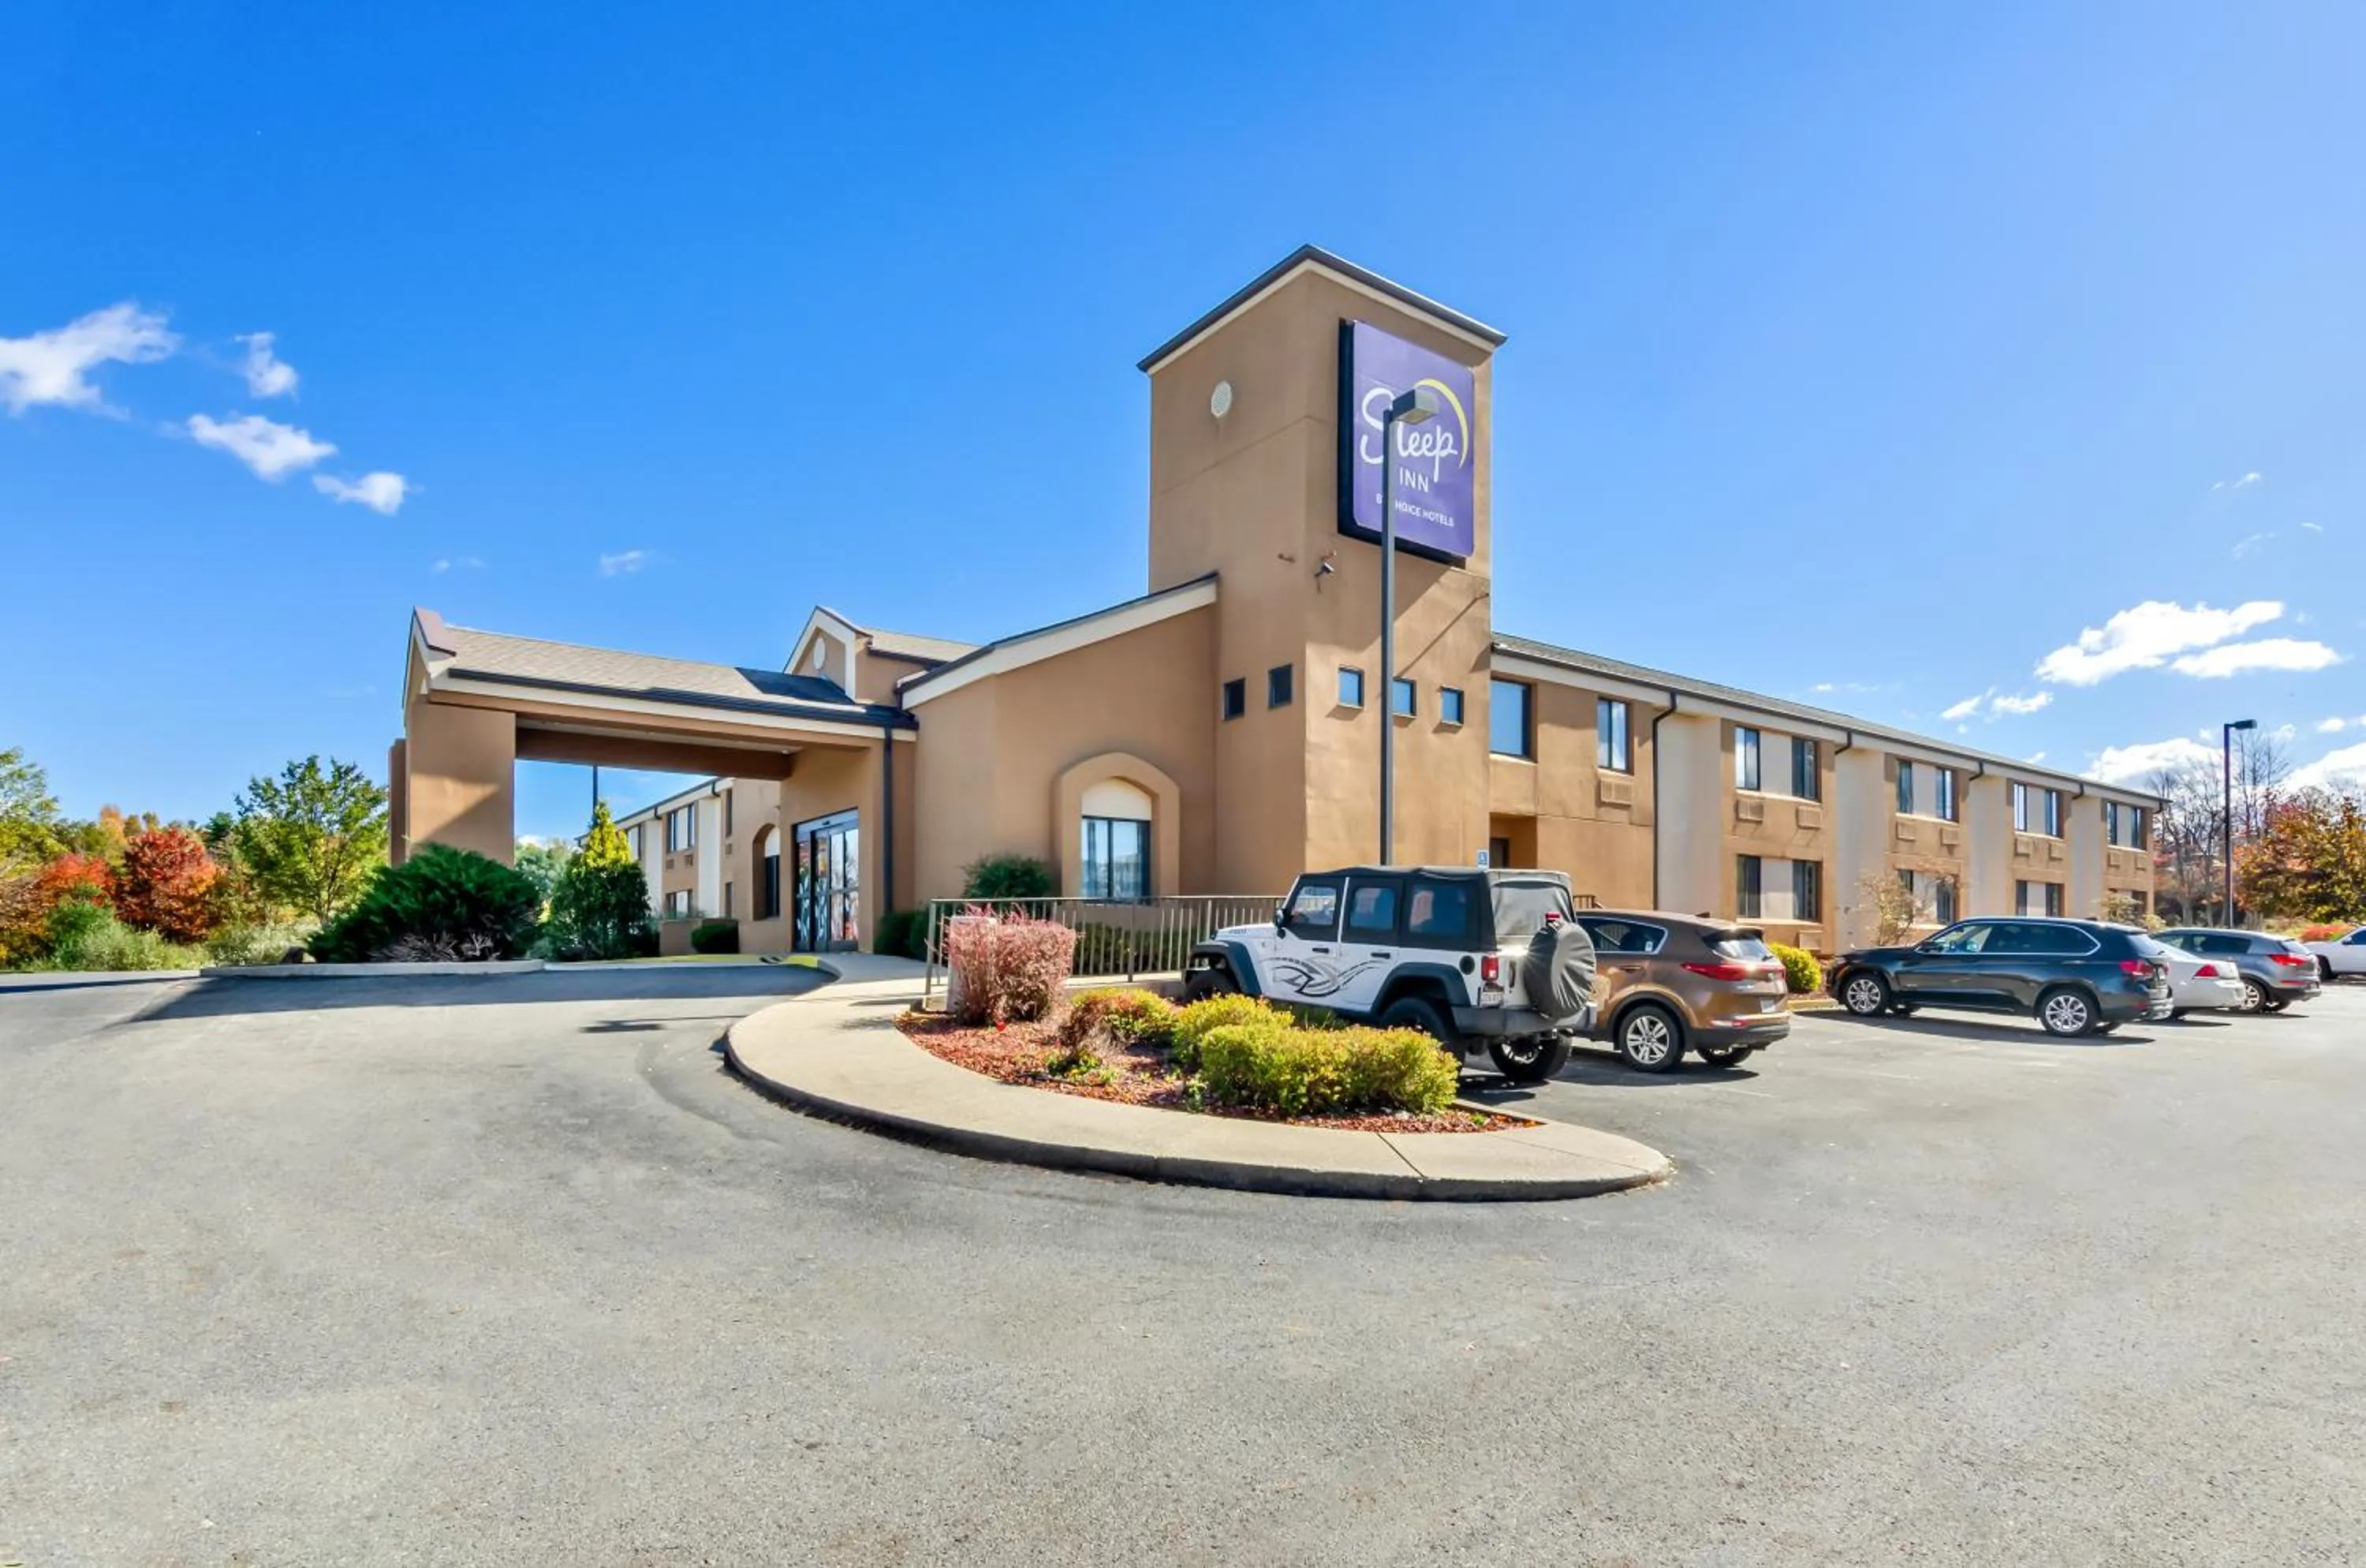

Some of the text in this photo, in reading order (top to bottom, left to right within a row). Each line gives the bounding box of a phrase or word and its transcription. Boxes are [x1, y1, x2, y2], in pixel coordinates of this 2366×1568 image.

[1360, 387, 1457, 483] Sleep
[1399, 466, 1428, 493] INN
[1394, 498, 1421, 517] HOICE
[1422, 509, 1454, 527] HOTELS
